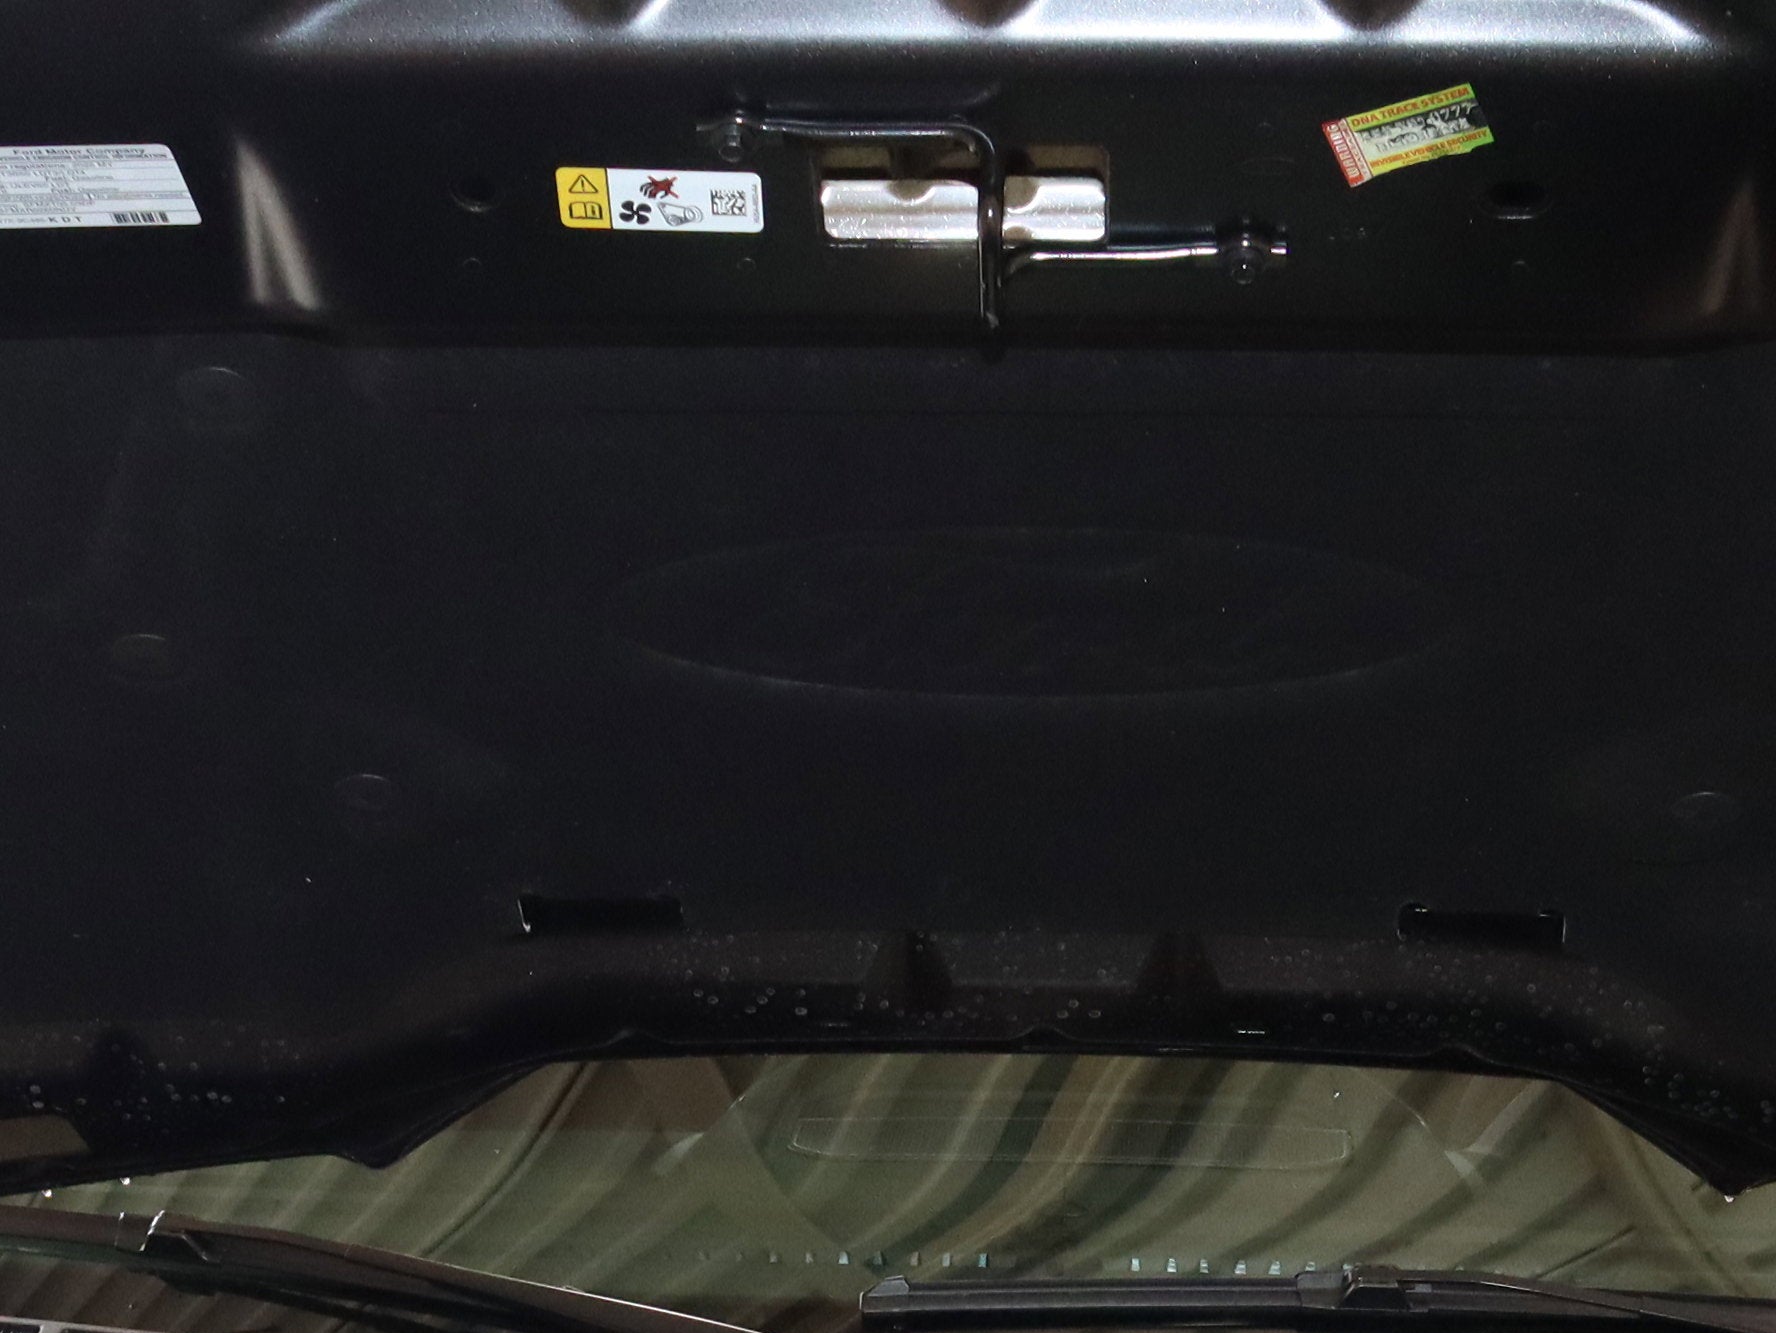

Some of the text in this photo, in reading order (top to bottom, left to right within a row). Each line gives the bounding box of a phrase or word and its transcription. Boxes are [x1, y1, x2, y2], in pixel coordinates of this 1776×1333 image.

[1351, 115, 1379, 127] DNA
[1421, 87, 1469, 107] SYSTEM
[1327, 124, 1359, 177] WARNING
